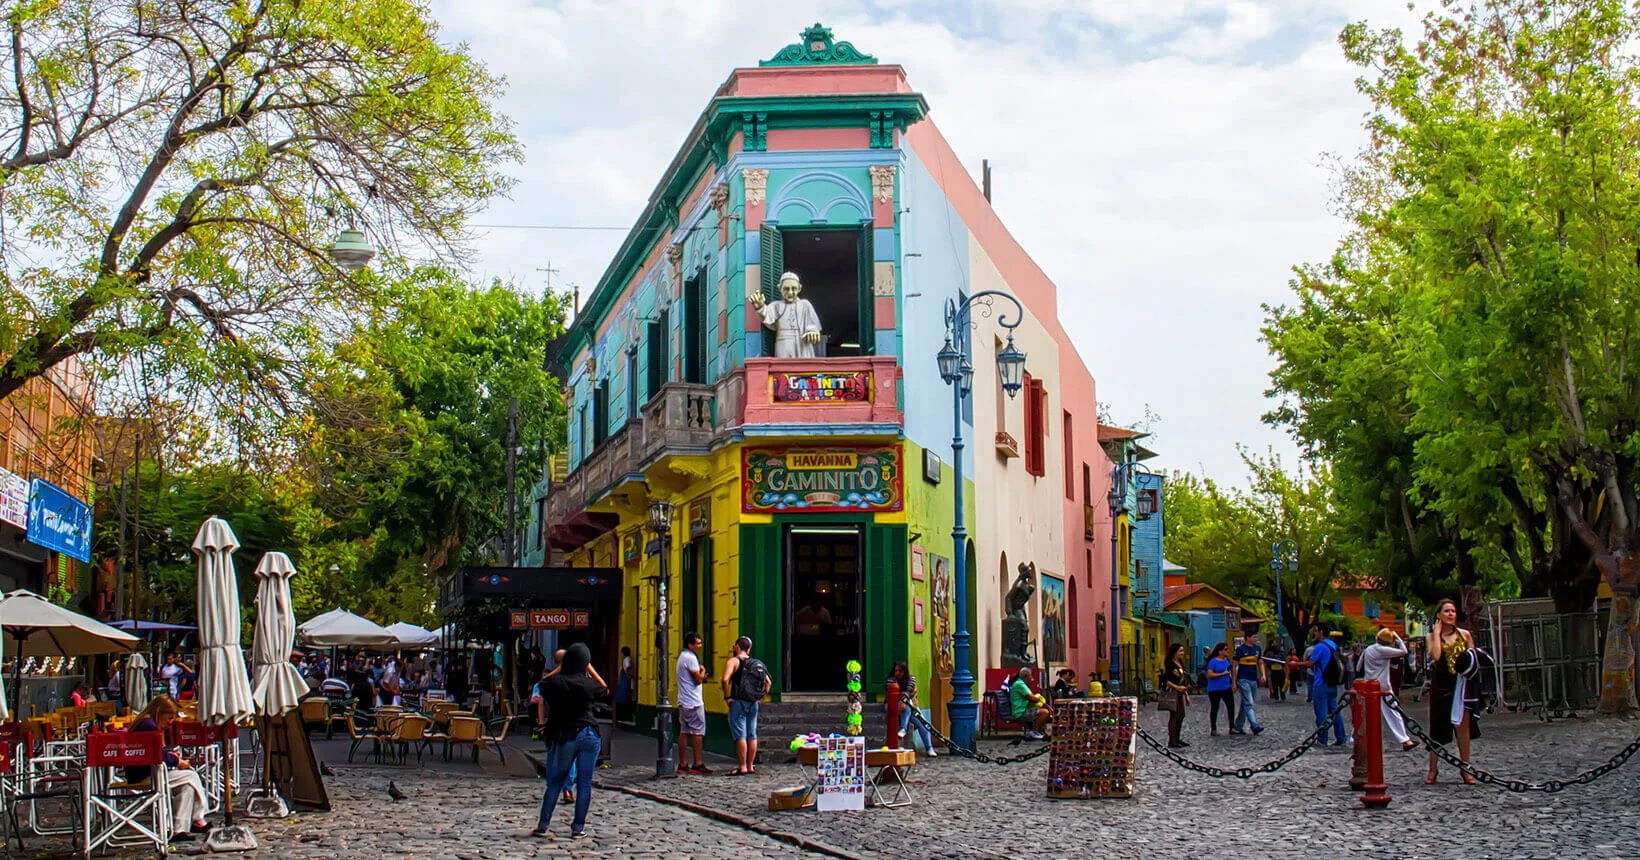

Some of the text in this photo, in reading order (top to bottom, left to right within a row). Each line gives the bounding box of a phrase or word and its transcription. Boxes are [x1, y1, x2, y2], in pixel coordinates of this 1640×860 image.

[793, 455, 852, 467] HAVANNA
[767, 467, 879, 491] CAMINITO
[534, 615, 566, 624] TANGO
